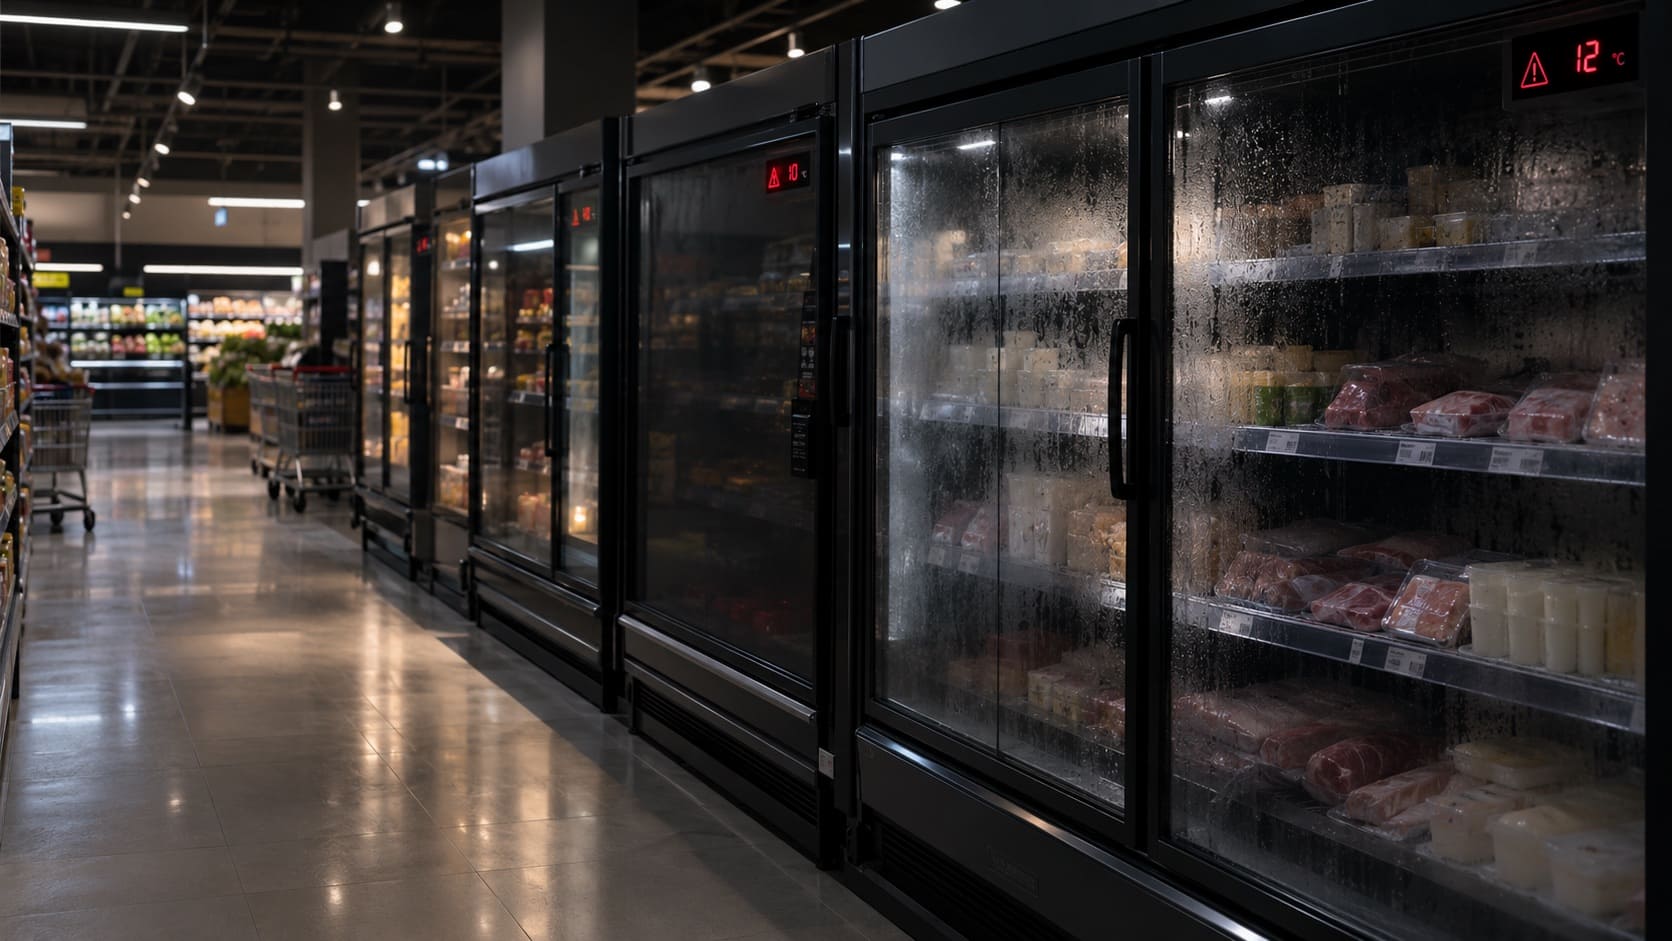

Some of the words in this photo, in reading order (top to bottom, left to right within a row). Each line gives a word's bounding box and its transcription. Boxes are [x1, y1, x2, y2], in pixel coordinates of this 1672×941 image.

[1577, 40, 1600, 72] 12
[1612, 52, 1625, 65] °C
[788, 163, 798, 181] 10
